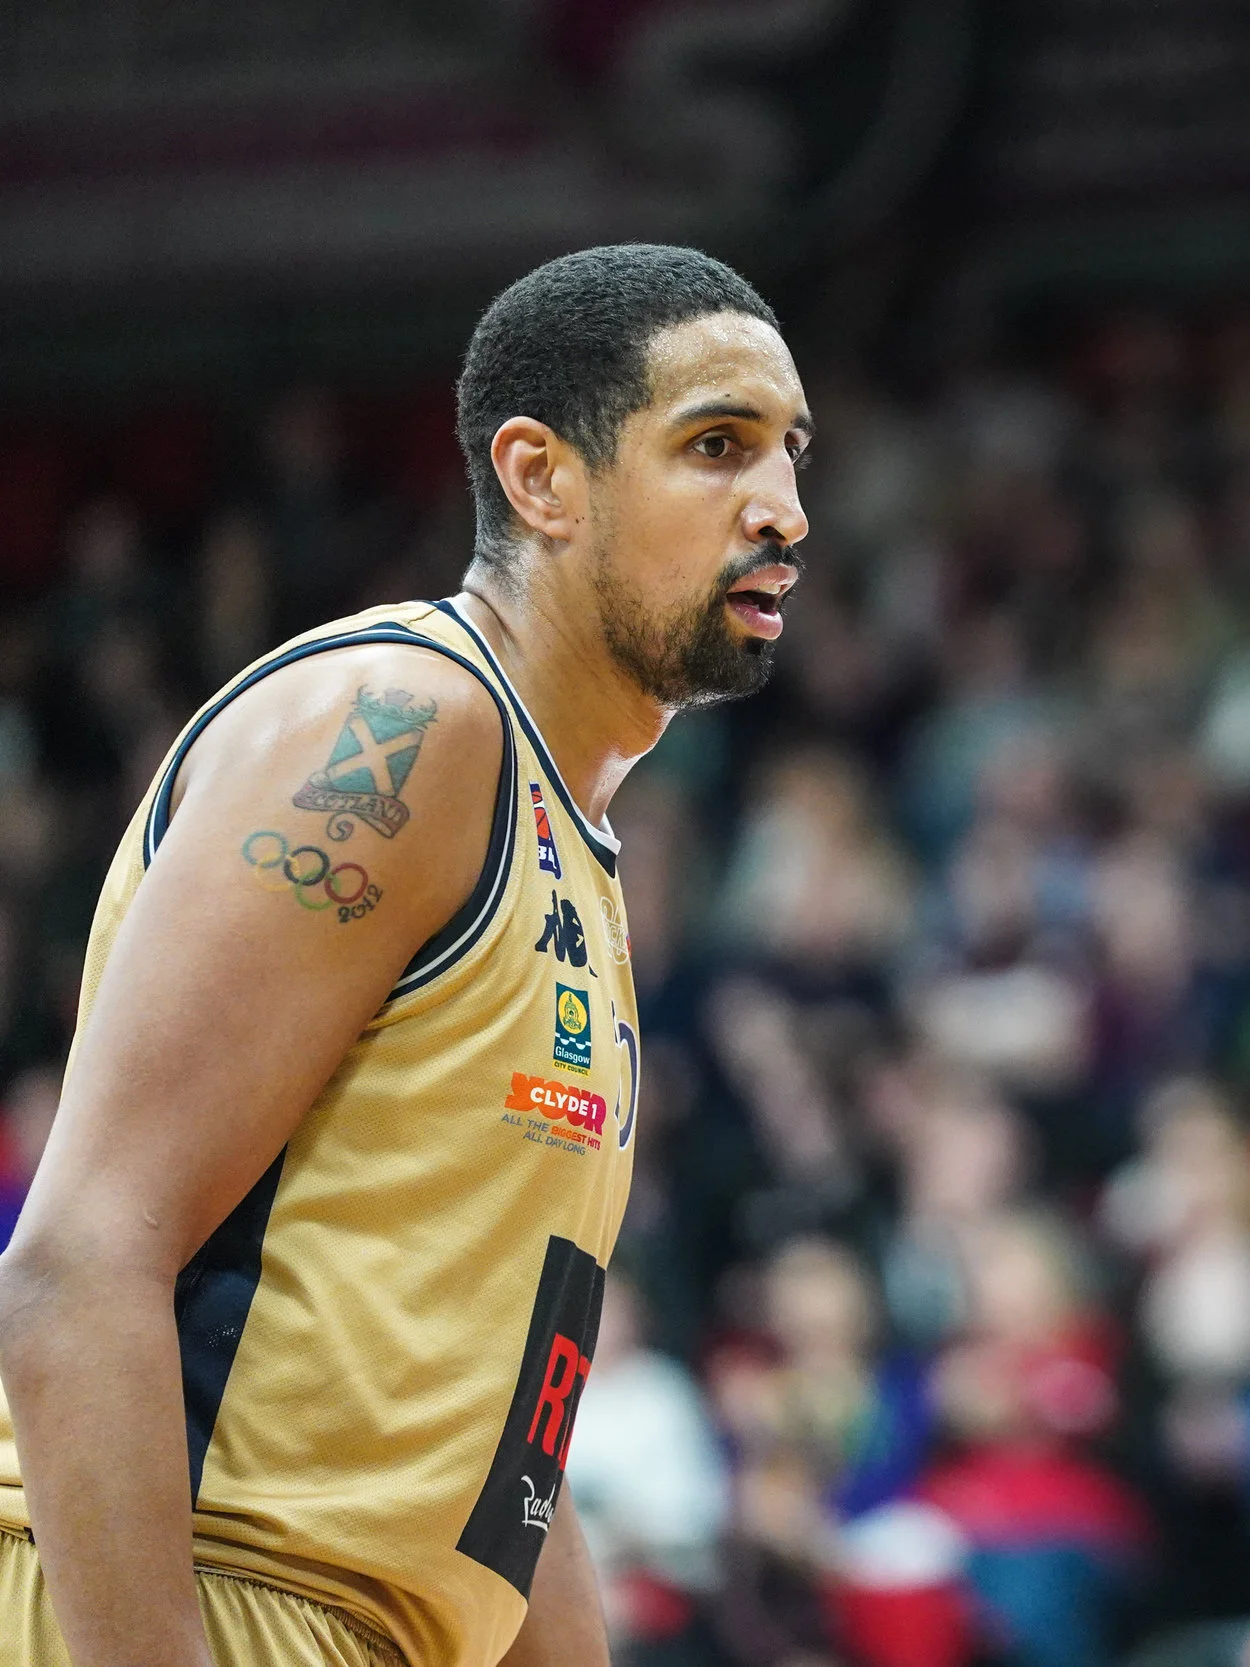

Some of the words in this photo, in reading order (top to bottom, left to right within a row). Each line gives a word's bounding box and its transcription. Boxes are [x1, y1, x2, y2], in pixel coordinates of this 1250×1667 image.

[338, 884, 383, 923] 2012
[555, 1045, 590, 1064] Glasgow
[554, 1061, 566, 1070] CITY
[567, 1065, 589, 1077] COUNCIL
[530, 1087, 589, 1116] CLYDE
[591, 1103, 599, 1120] 1
[502, 1114, 523, 1127] ALL
[528, 1118, 549, 1133] THE
[551, 1125, 588, 1144] BIGGEST
[523, 1129, 543, 1144] ALL
[545, 1136, 564, 1149] DAY
[564, 1140, 587, 1156] LONG
